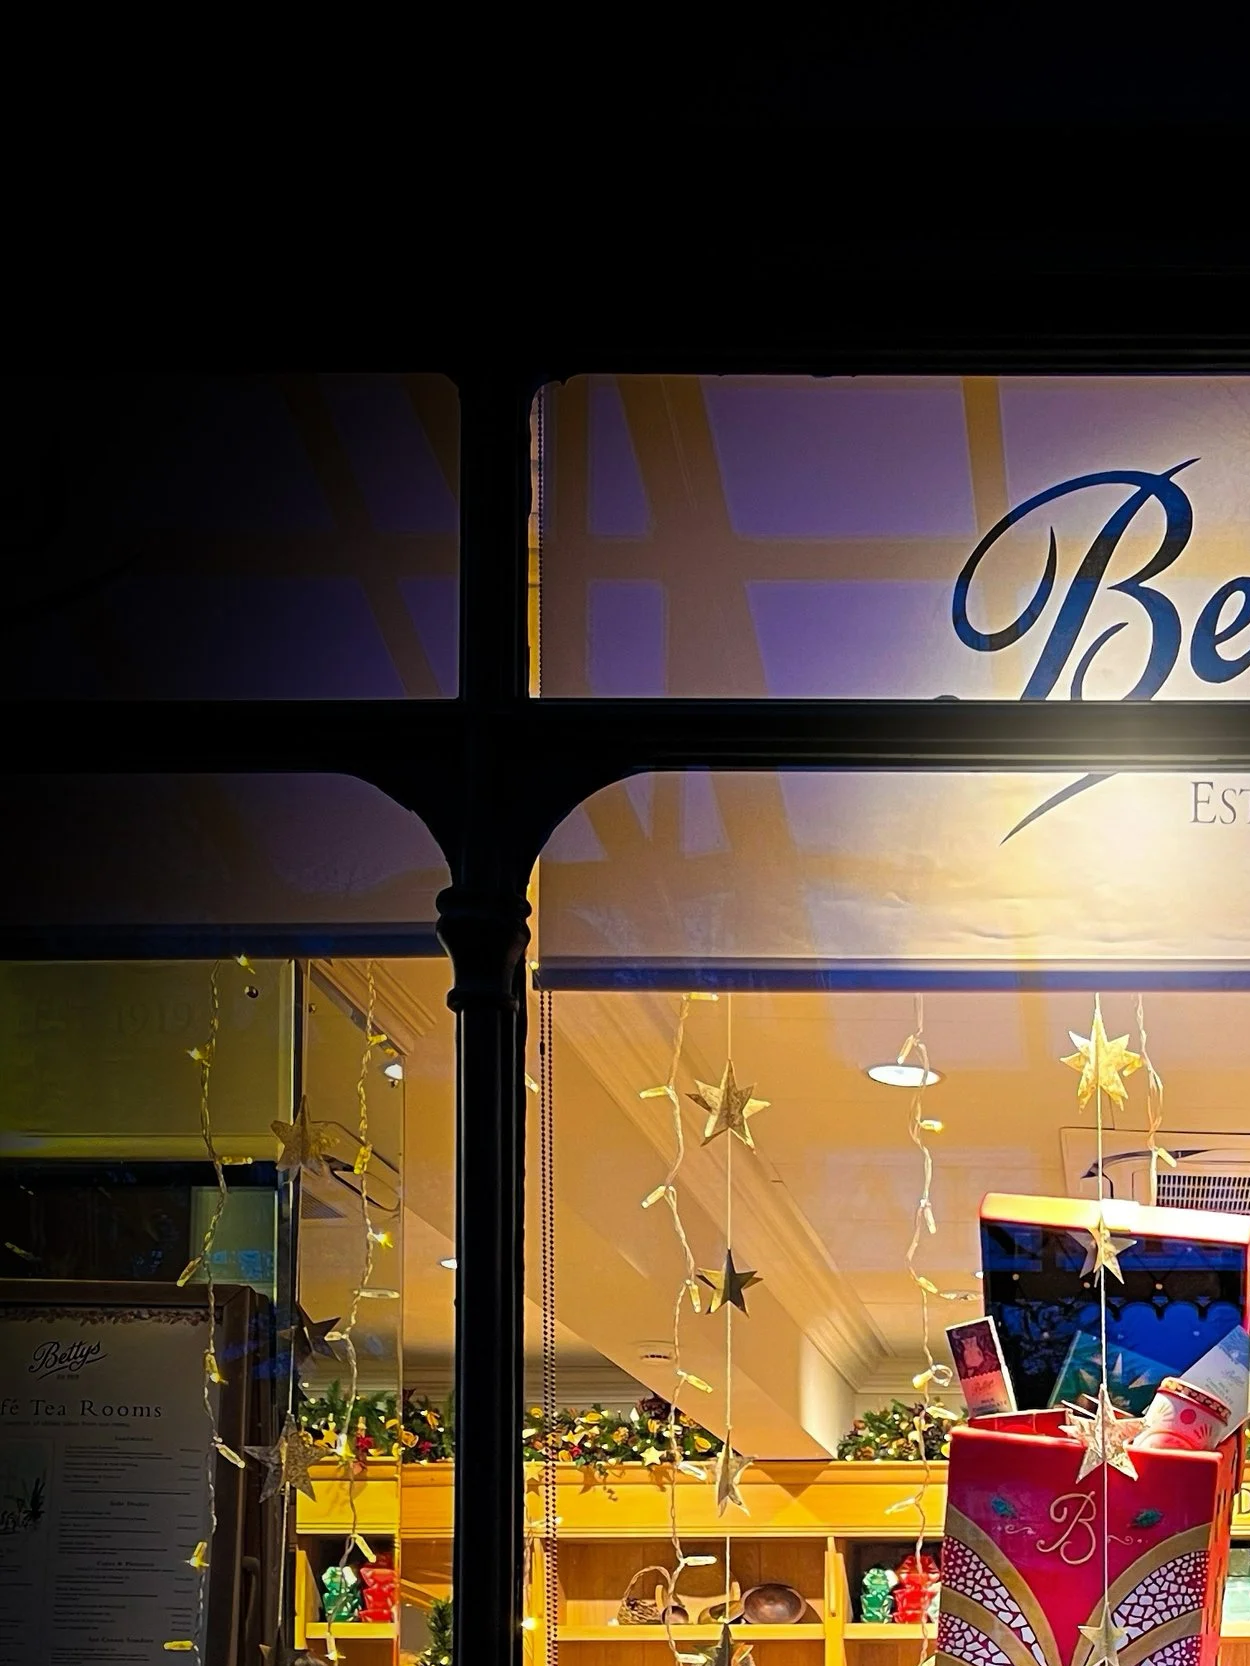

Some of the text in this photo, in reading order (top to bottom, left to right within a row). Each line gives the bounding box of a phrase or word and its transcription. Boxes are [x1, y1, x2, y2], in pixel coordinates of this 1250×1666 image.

[29, 1340, 109, 1381] Bettys
[0, 1398, 162, 1418] fé Tea Rooms
[1036, 1490, 1097, 1565] B
